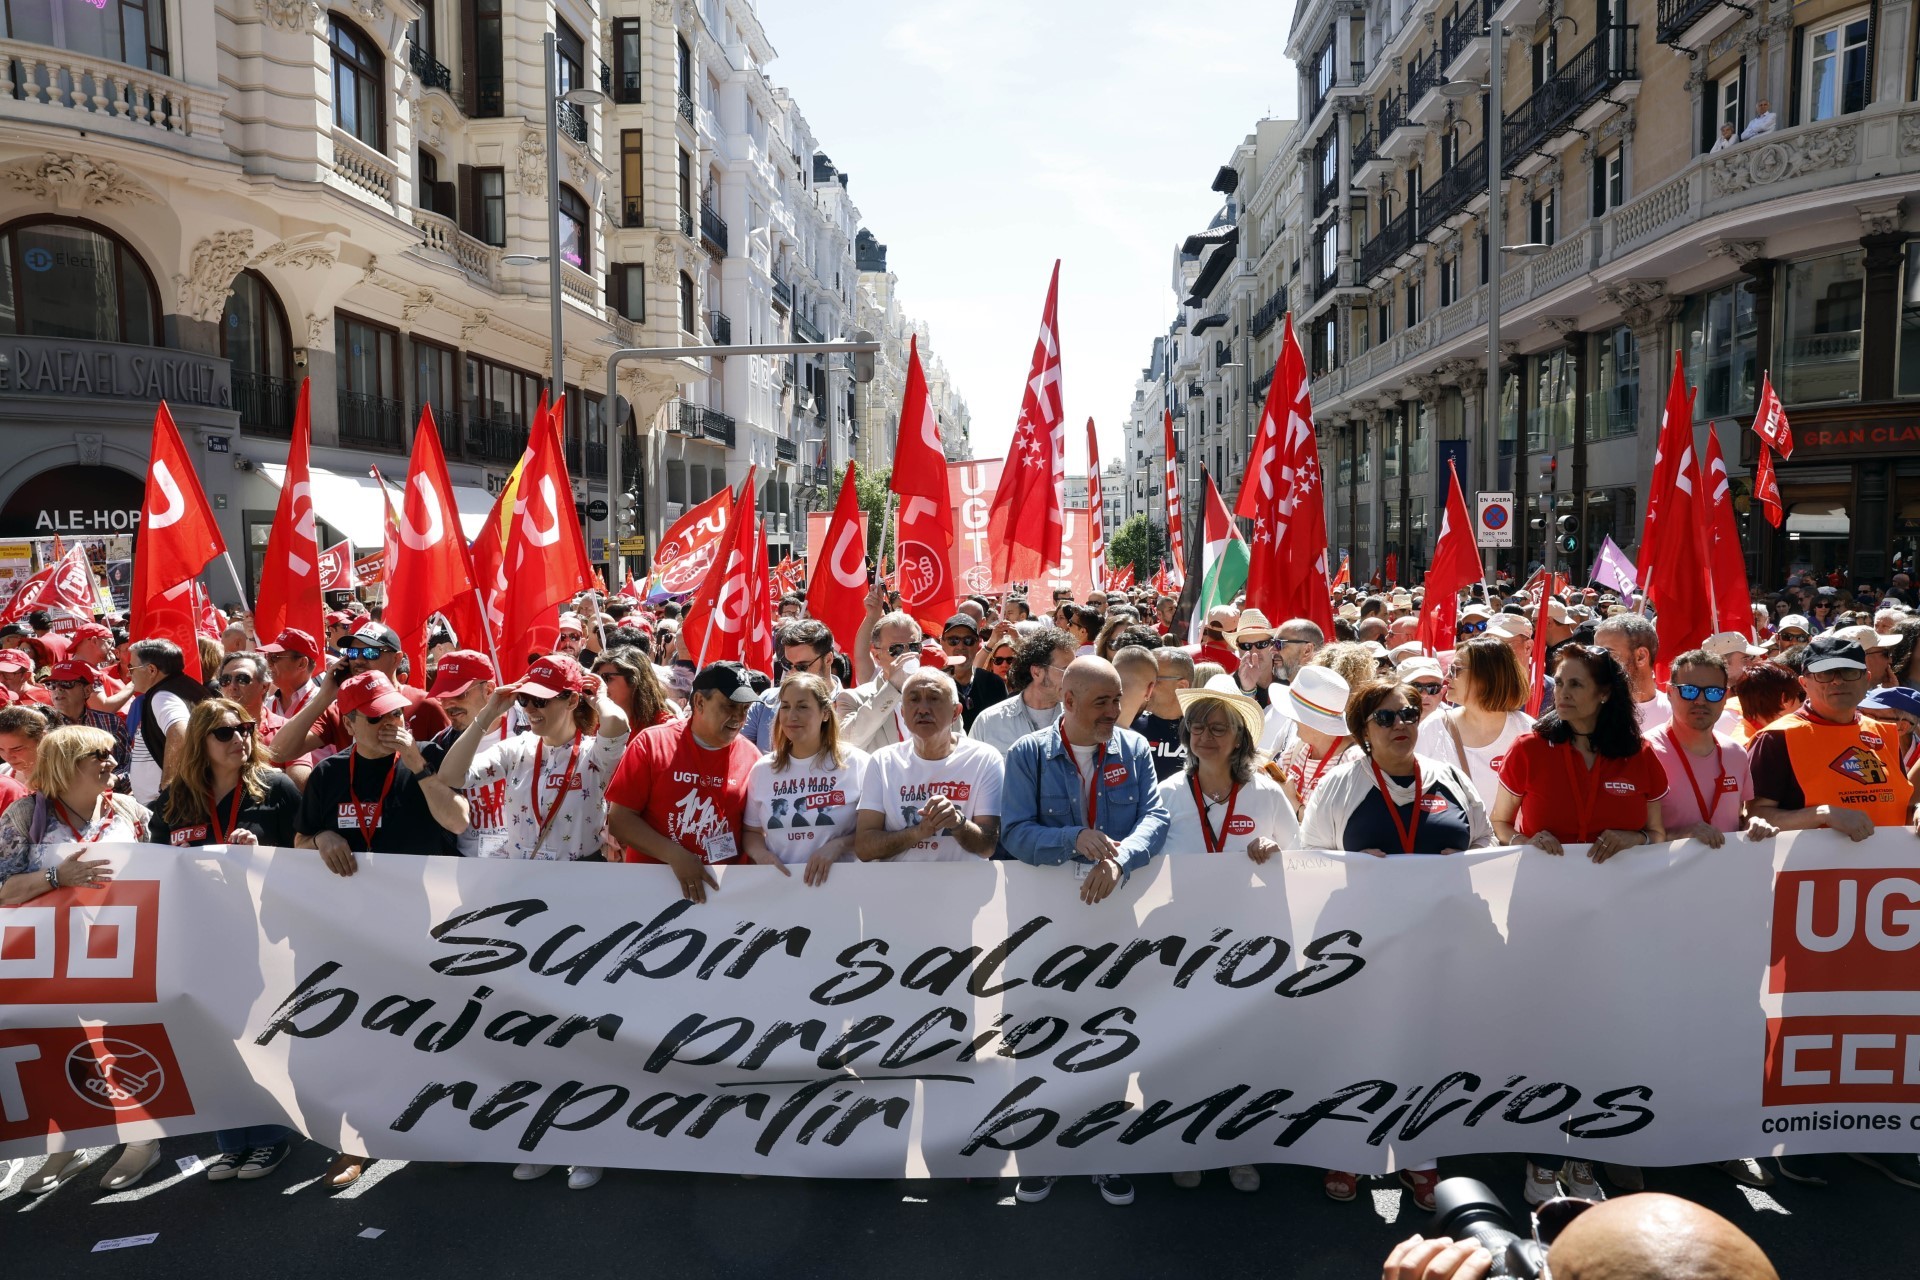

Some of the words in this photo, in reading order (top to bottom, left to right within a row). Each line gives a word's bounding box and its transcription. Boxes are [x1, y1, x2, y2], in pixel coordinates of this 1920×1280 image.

[15, 347, 124, 395] RAFAEL
[131, 356, 216, 407] SANCHEZ
[1804, 428, 1864, 446] GRAN
[35, 510, 141, 530] ALE-HOP
[960, 464, 989, 563] UGT
[674, 771, 700, 785] UGT
[773, 776, 837, 793] GANAMOS
[1604, 781, 1635, 791] CCOO
[774, 786, 798, 796] TODAS
[808, 782, 834, 793] TODOS
[931, 785, 957, 798] UGT
[806, 794, 831, 807] UGT
[1840, 794, 1877, 804] METRO
[170, 828, 193, 844] UGT
[787, 832, 806, 841] UGT
[429, 898, 811, 985] Subir
[809, 916, 1366, 1006] salarios
[253, 960, 624, 1053] bajar
[642, 1006, 1141, 1074] precios
[389, 1074, 912, 1157] repartir
[959, 1071, 1656, 1156] beneficios
[1762, 1110, 1901, 1134] comisiones
